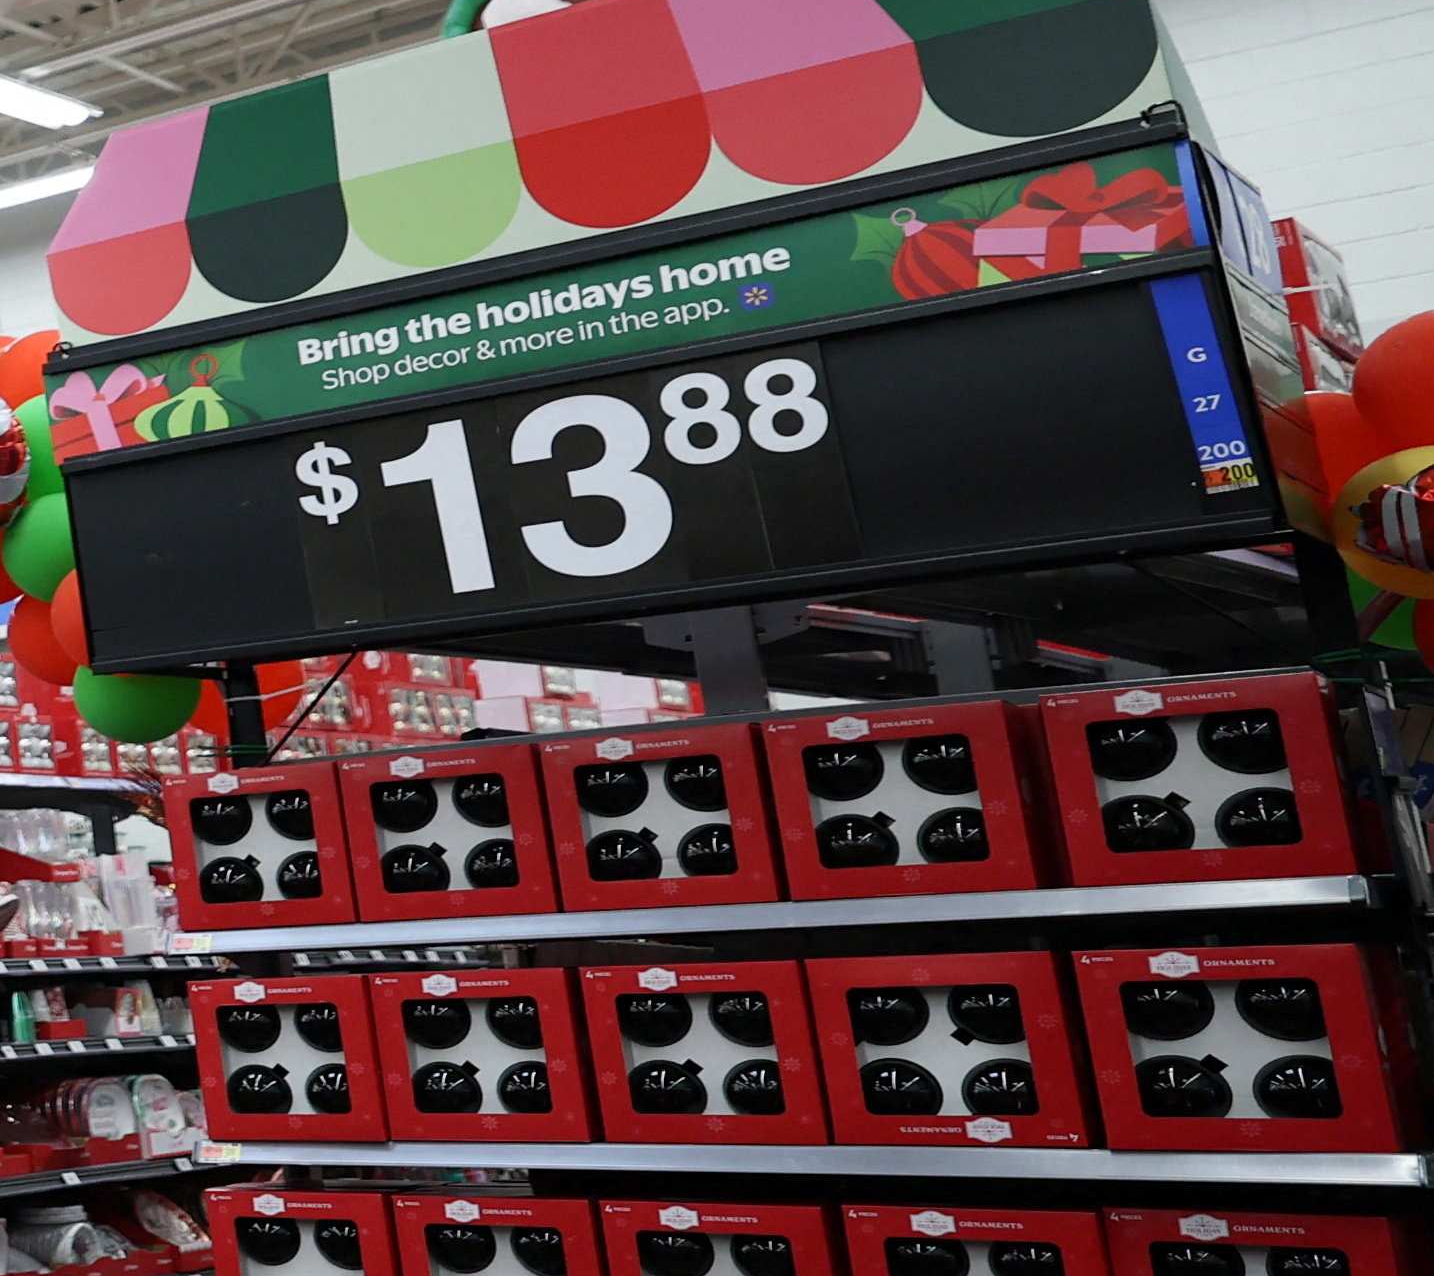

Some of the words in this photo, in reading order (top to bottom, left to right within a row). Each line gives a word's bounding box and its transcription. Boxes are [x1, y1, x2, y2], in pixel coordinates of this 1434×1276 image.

[297, 325, 399, 367] Bring
[403, 311, 472, 345] the
[476, 272, 655, 331] holidays
[659, 246, 792, 293] home
[320, 361, 392, 391] Shop
[393, 346, 469, 377] decor
[476, 340, 497, 361] &
[499, 328, 575, 357] more
[578, 318, 606, 341] in
[607, 308, 659, 335] the
[663, 292, 732, 327] app.
[1186, 346, 1208, 363] G
[1192, 393, 1222, 413] 27
[1197, 439, 1246, 461] 200
[1220, 462, 1256, 484] 200
[1165, 690, 1237, 704] ORNAMENTS
[1202, 958, 1276, 968] ORNAMENTS
[959, 1221, 1024, 1230] ORNAMENTS
